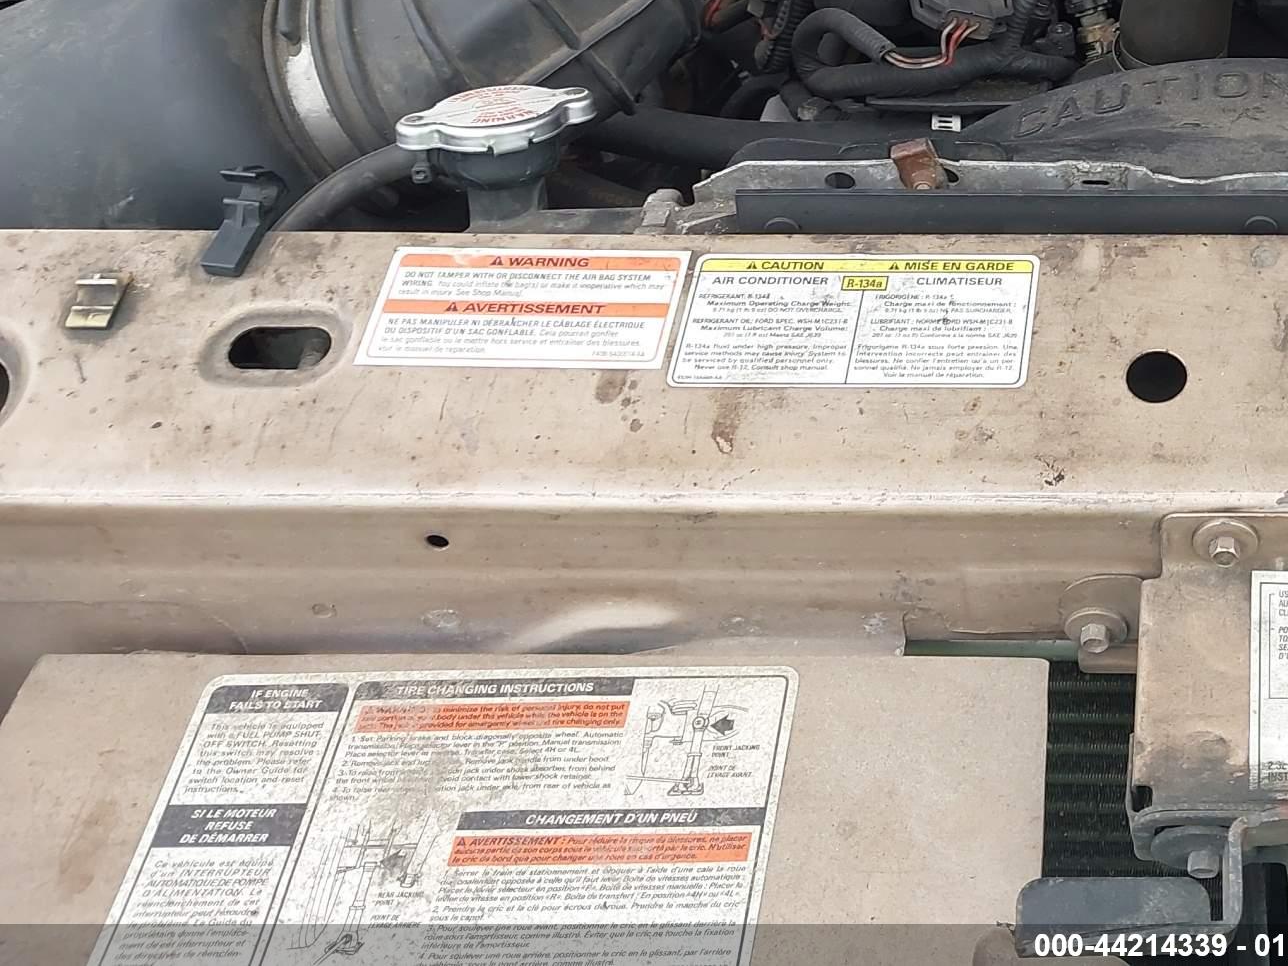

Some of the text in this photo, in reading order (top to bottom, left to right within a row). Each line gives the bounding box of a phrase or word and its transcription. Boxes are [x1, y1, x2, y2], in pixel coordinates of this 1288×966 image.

[508, 256, 590, 268] WARNING
[761, 261, 825, 270] CAUTION
[904, 261, 1015, 271] MISE EN GARDE
[436, 271, 471, 279] TAMPER
[509, 272, 563, 280] DISCONNECT
[582, 273, 597, 281] AIR
[712, 276, 829, 285] AIR CONDITIONER
[916, 277, 1003, 286] CLIMATISEUR
[846, 279, 883, 288] R-134a
[462, 303, 607, 314] AVERTISSEMENT
[251, 689, 310, 699] IF ENGINE
[397, 682, 595, 696] TIRE CHANGING INSTRUCTIONS
[228, 699, 323, 710] FAILS TO START
[190, 808, 277, 819] SI LE MOTEUR
[525, 811, 698, 826] CHANGEMENT D'UN PNEU
[204, 821, 254, 832] REFUSE
[179, 832, 269, 844] DE DÉMARRER
